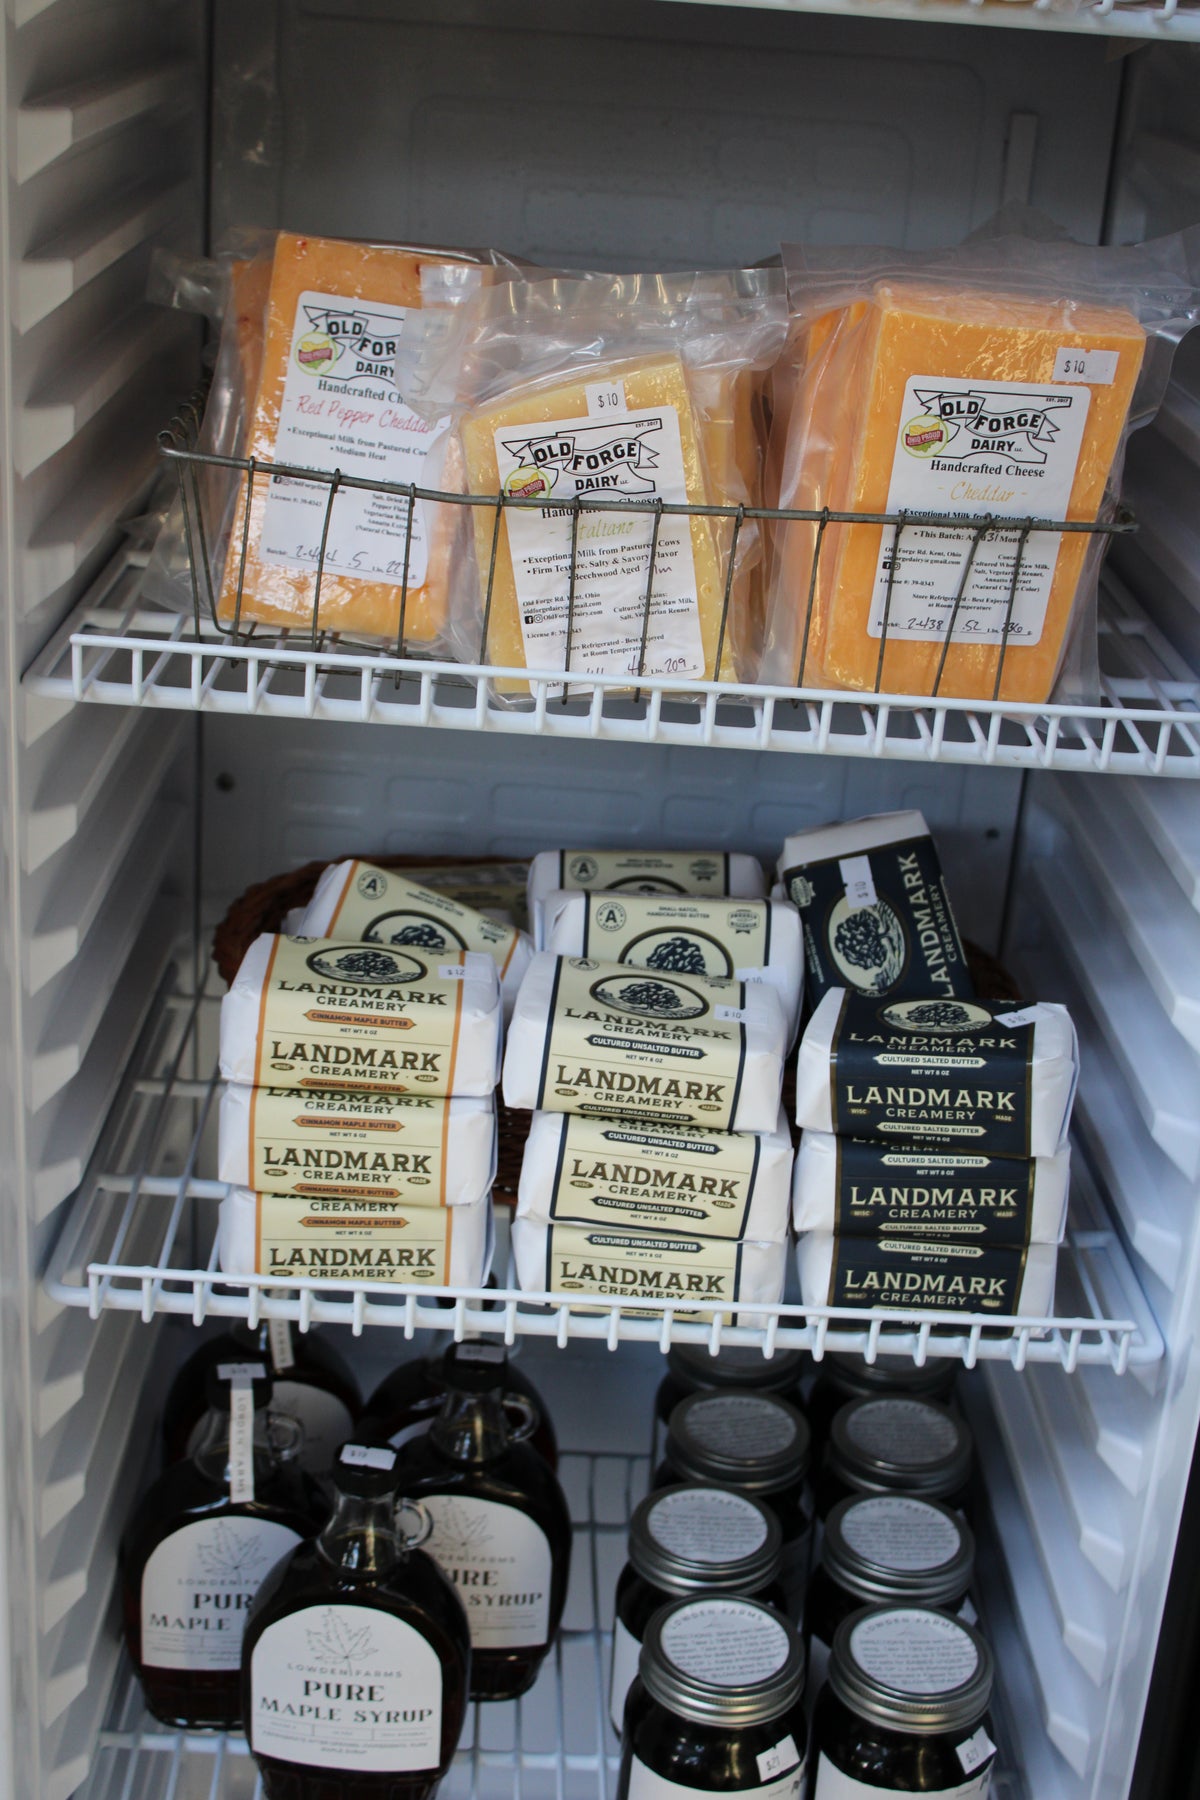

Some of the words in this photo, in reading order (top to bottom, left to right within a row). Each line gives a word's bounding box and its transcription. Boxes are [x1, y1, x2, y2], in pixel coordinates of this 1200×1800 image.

[327, 320, 363, 336] OLD
[358, 337, 397, 356] FOR
[318, 380, 385, 401] Handcrafted
[296, 395, 322, 415] Red
[328, 399, 375, 429] Pepper
[941, 400, 979, 416] OLD
[973, 413, 1041, 433] FORGE
[292, 426, 336, 441] Exceptional
[338, 434, 355, 444] Milk
[357, 438, 377, 448] from
[377, 441, 411, 455] Pastured
[971, 438, 1015, 451] DAIRY
[335, 445, 367, 458] Medium
[368, 450, 387, 461] Heat
[533, 442, 571, 463] OLD
[572, 442, 638, 471] FORGE
[930, 460, 1002, 475] Handcrafted
[1005, 464, 1046, 478] Cheese
[575, 474, 620, 491] DAIRY
[950, 481, 1016, 502] Cheddar
[578, 549, 596, 558] Milk
[599, 545, 618, 556] from
[658, 539, 681, 547] Cows
[532, 567, 553, 576] Firm
[589, 560, 610, 570] Salty
[611, 557, 620, 565] &
[621, 553, 650, 564] Savory
[620, 565, 641, 576] Aged
[897, 851, 956, 998] LANDMARK
[928, 884, 957, 962] CREAMERY
[278, 980, 448, 1006] LANDMARK
[316, 996, 407, 1011] CREAMERY
[312, 1012, 351, 1022] CINNAMON
[354, 1016, 378, 1024] MAPLE
[380, 1019, 408, 1027] BUTTER
[565, 1007, 732, 1040] LANDMARK
[603, 1024, 692, 1042] CREAMERY
[849, 1033, 1018, 1049] LANDMARK
[592, 1037, 631, 1048] CULTURED
[632, 1041, 670, 1054] UNSALTED
[671, 1047, 700, 1057] BUTTER
[886, 1045, 977, 1054] CREAMERY
[271, 1041, 441, 1072] LANDMARK
[310, 1066, 399, 1080] CREAMERY
[305, 1080, 346, 1088] CINNAMON
[556, 1065, 726, 1102] LANDMARK
[266, 1087, 435, 1108] LANDMARK
[594, 1092, 683, 1108] CREAMERY
[846, 1085, 1016, 1111] LANDMARK
[305, 1101, 395, 1114] CREAMERY
[583, 1105, 621, 1114] CULTURED
[623, 1108, 660, 1117] UNSALTED
[661, 1113, 689, 1121] BUTTER
[886, 1108, 976, 1120] CREAMERY
[301, 1118, 340, 1126] CINNAMON
[618, 1124, 706, 1138] CREAMERY
[608, 1132, 646, 1143] CULTURED
[648, 1138, 685, 1148] UNSALTED
[687, 1143, 715, 1152] BUTTER
[264, 1147, 432, 1174] LANDMARK
[303, 1170, 392, 1183] CREAMERY
[571, 1159, 741, 1199] LANDMARK
[609, 1185, 698, 1202] CREAMERY
[850, 1186, 1018, 1207] LANDMARK
[310, 1202, 399, 1211] CREAMERY
[597, 1199, 635, 1209] CULTURED
[637, 1204, 673, 1213] UNSALTED
[675, 1208, 703, 1217] BUTTER
[888, 1209, 978, 1218] CREAMERY
[592, 1236, 630, 1246] CULTURED
[631, 1239, 668, 1249] UNSALTED
[670, 1243, 697, 1251] BUTTER
[884, 1242, 921, 1251] CULTURED
[923, 1245, 950, 1253] SALTED
[270, 1248, 436, 1266] LANDMARK
[309, 1269, 396, 1278] CREAMERY
[560, 1261, 725, 1293] LANDMARK
[845, 1270, 1007, 1296] LANDMARK
[598, 1285, 686, 1300] CREAMERY
[880, 1292, 967, 1305] CREAMERY
[193, 1593, 254, 1610] PUR
[468, 1592, 542, 1606] SYRUP
[149, 1613, 231, 1631] MAPLE
[287, 1663, 348, 1676] LOWDEN
[355, 1668, 402, 1678] FARMS
[304, 1680, 385, 1702] PURE
[260, 1697, 342, 1721] MAPLE
[353, 1709, 433, 1723] SYRUP
